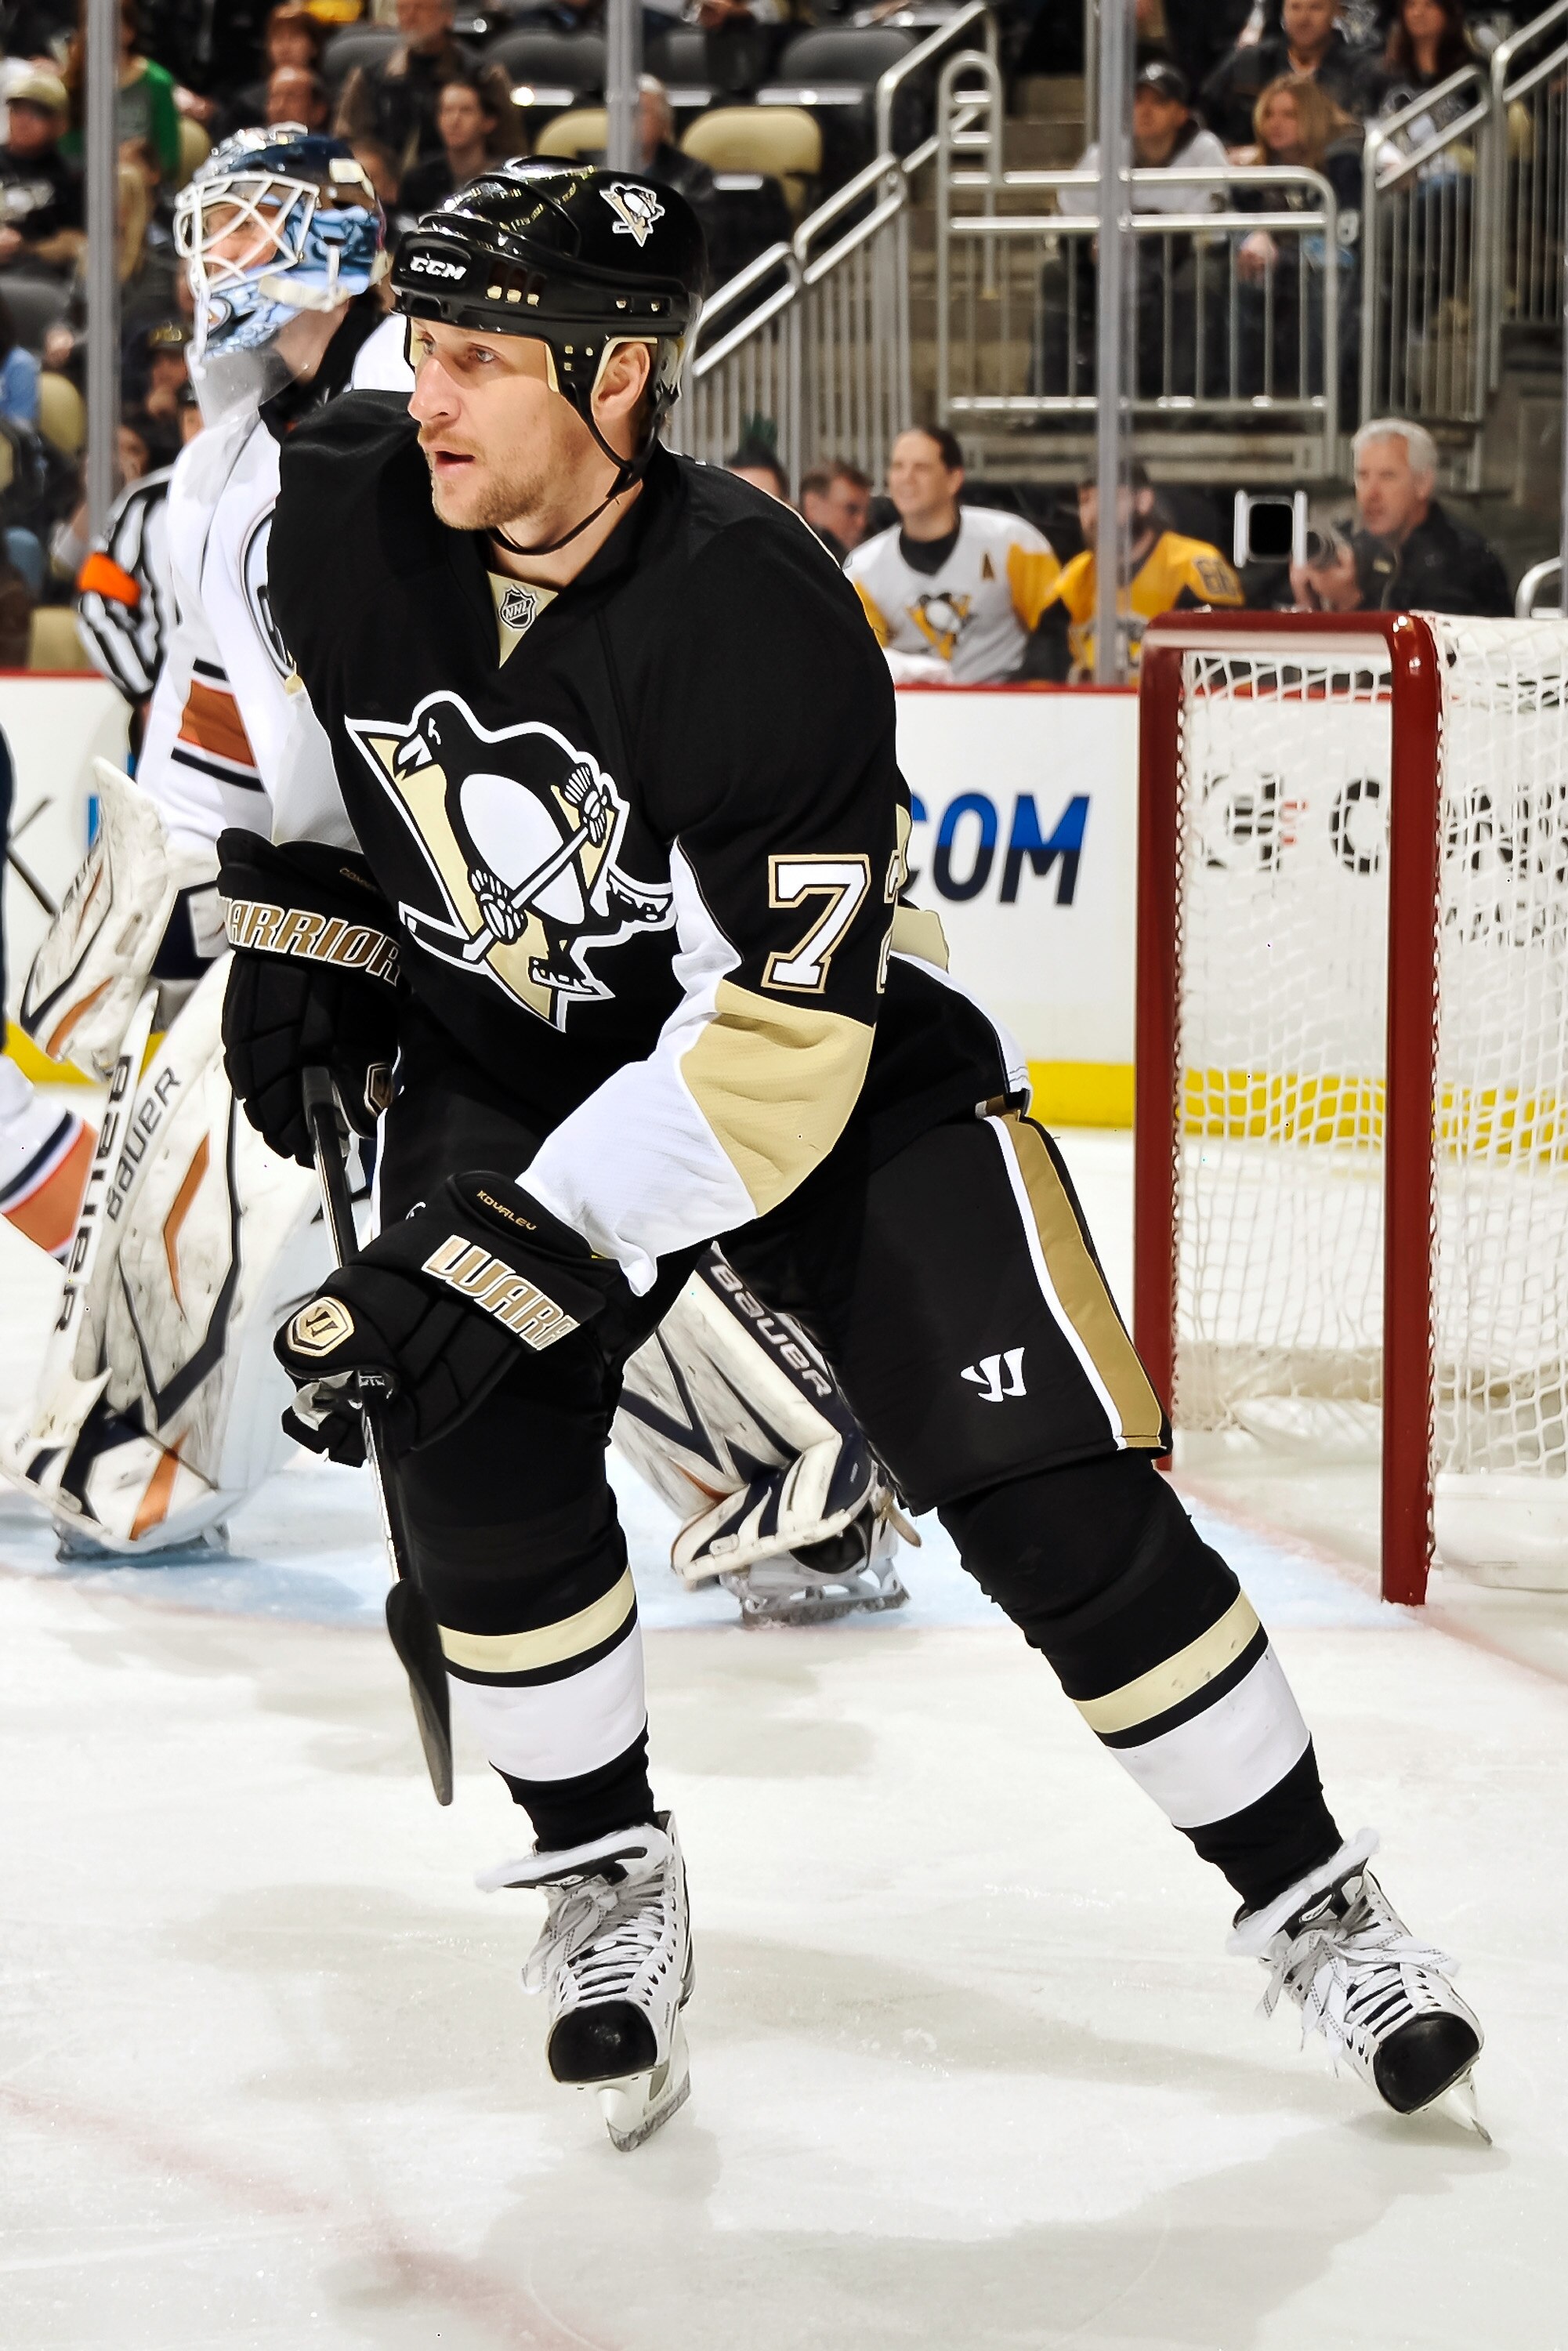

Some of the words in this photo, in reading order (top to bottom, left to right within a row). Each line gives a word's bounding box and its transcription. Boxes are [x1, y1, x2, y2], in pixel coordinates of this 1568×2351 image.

[410, 255, 467, 280] CCM
[505, 600, 531, 620] NHL
[225, 899, 403, 987] ARRIOR
[476, 1190, 538, 1231] KOVALEV
